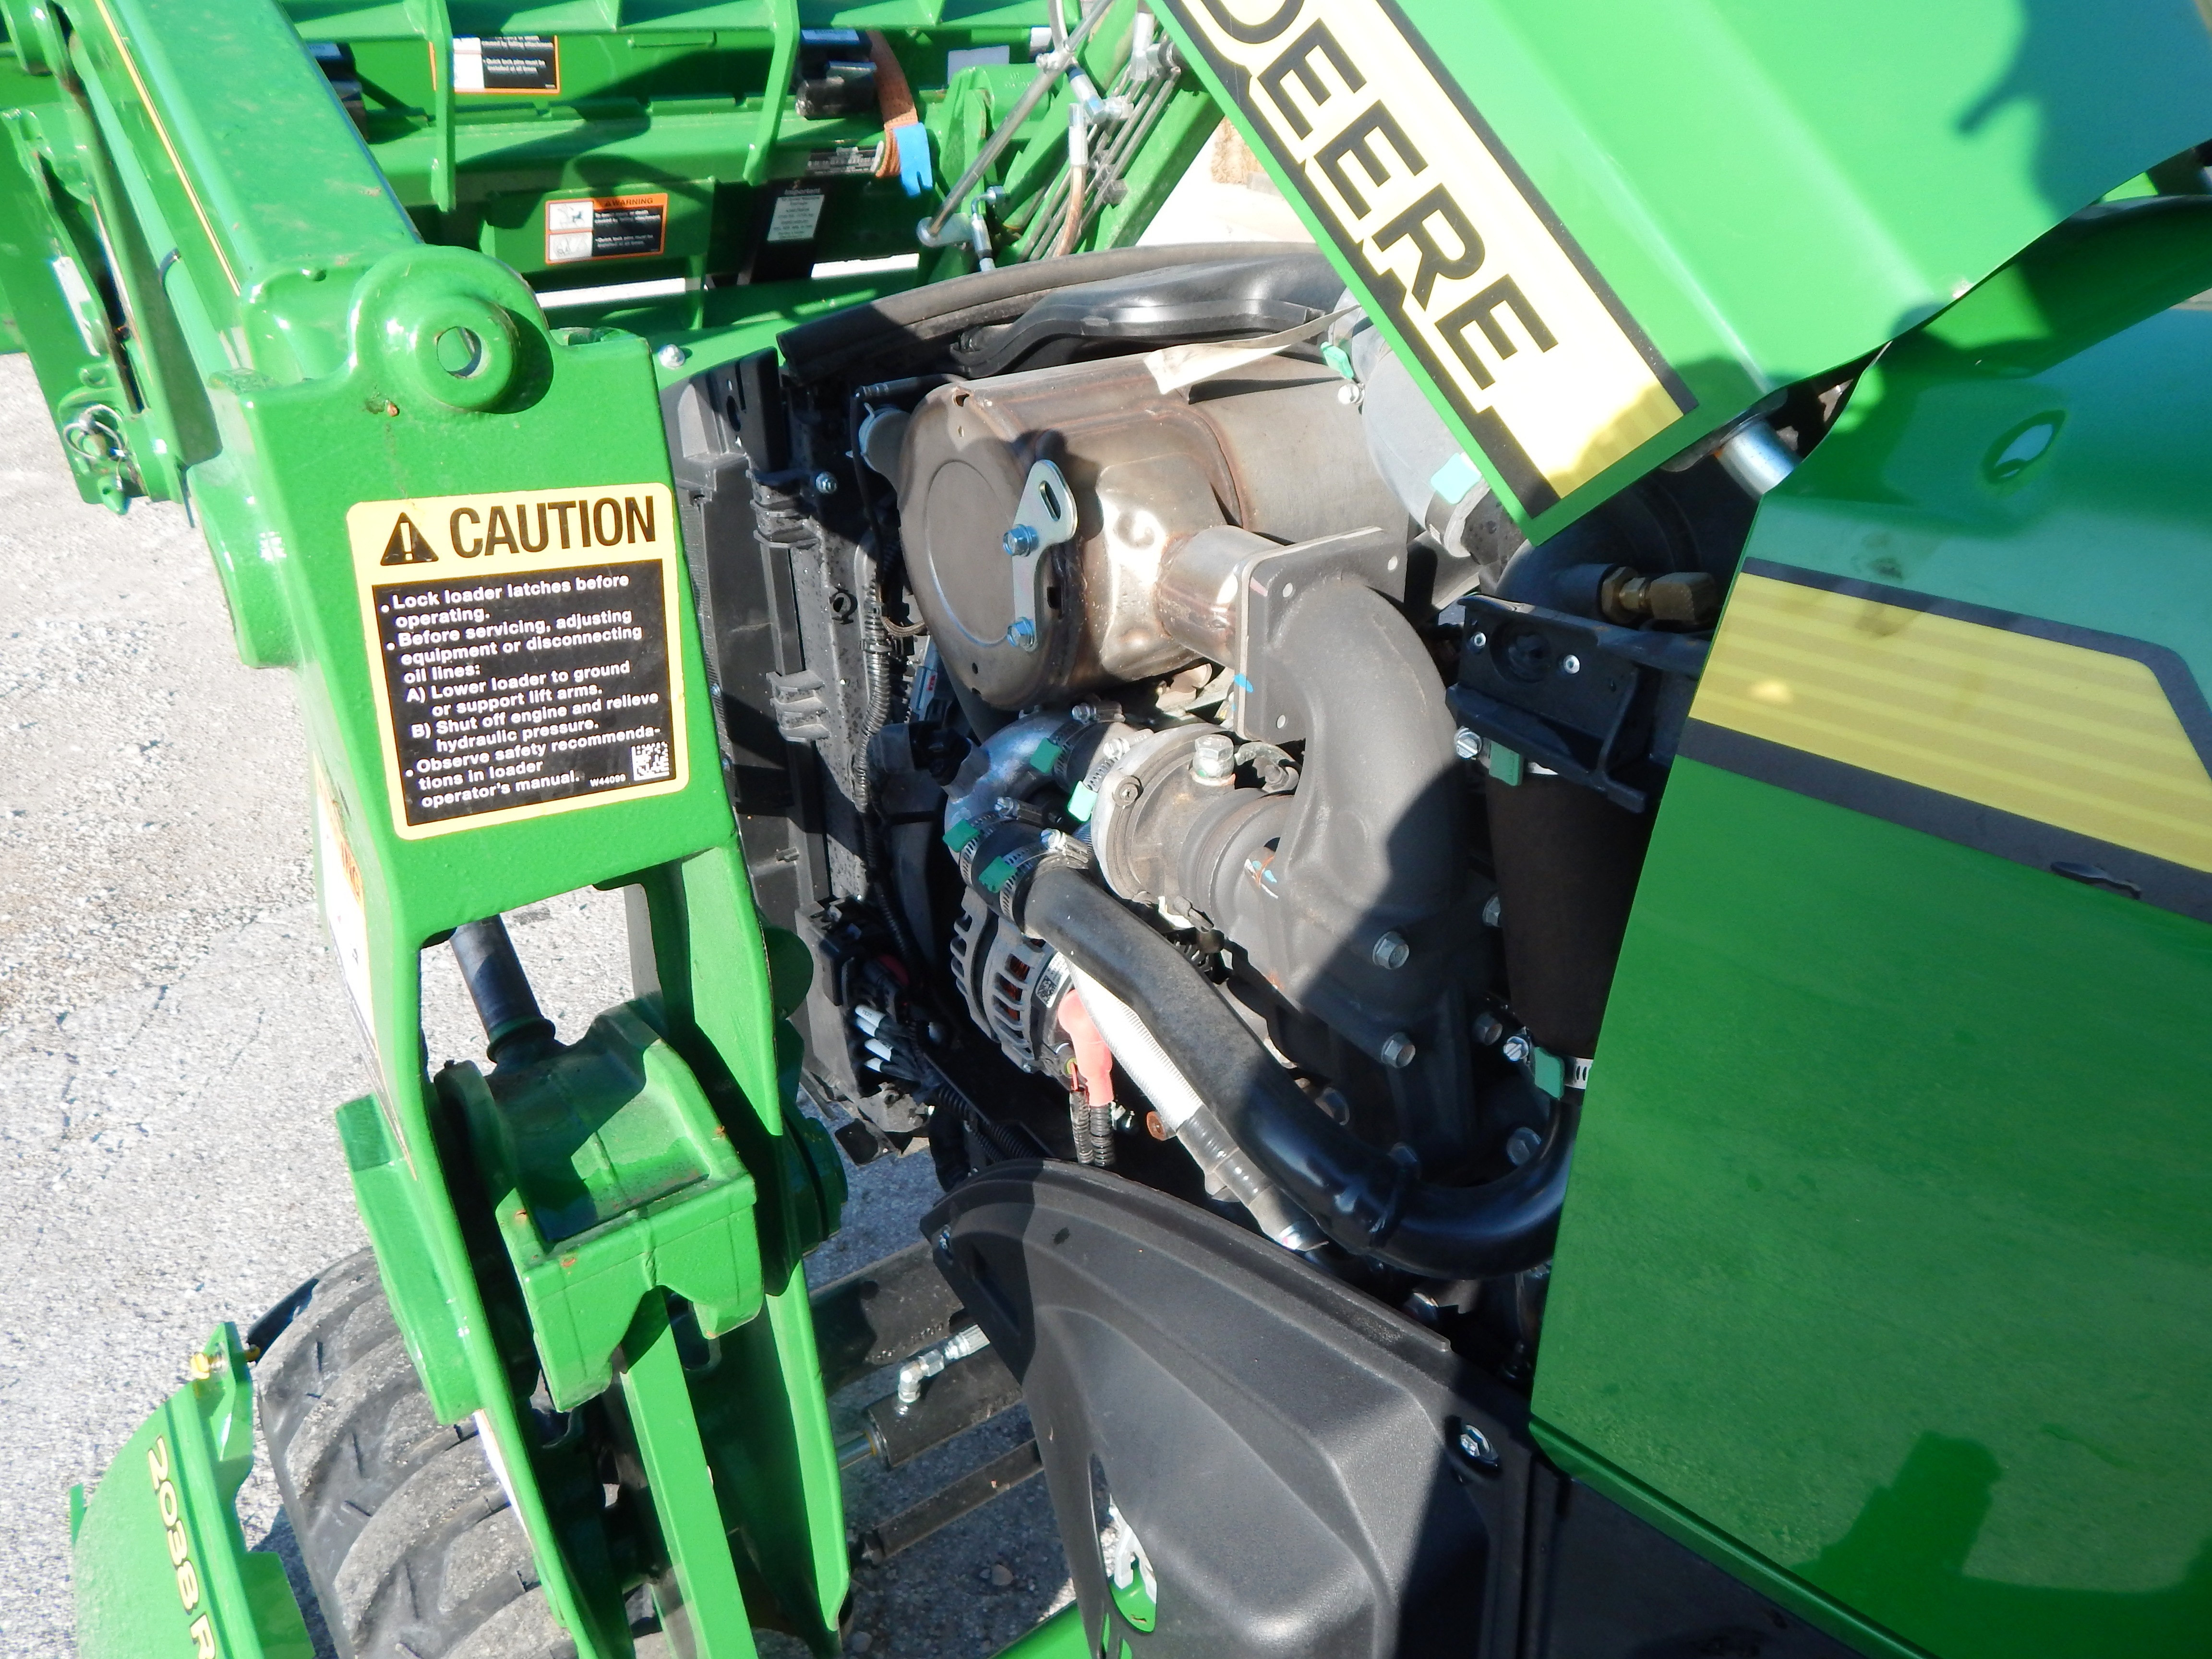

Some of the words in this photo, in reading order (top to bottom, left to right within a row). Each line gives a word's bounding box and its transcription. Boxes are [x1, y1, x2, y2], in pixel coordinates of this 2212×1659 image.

[612, 197, 653, 206] WARNING
[450, 495, 656, 559] CAUTION
[392, 591, 440, 610] Lock
[445, 586, 503, 604] loader
[507, 580, 571, 598] latches
[576, 575, 629, 591] before
[395, 607, 490, 630] operating.
[398, 629, 460, 647] Before
[465, 620, 551, 640] servicing,
[556, 610, 632, 630] adjusting
[401, 642, 498, 666] equipment
[502, 641, 521, 654] or
[526, 626, 642, 651] disconnecting
[404, 668, 427, 684] oil
[432, 663, 481, 681] lines:
[406, 686, 426, 703] A)
[431, 681, 487, 699] Lower
[491, 673, 547, 691] loader
[551, 670, 569, 684] to
[573, 660, 630, 683] ground
[411, 722, 431, 739] B)
[436, 717, 478, 735] Shut
[481, 711, 507, 728] off
[510, 706, 567, 724] engine
[572, 698, 602, 715] and
[606, 693, 659, 710] relieve
[432, 704, 452, 718] or
[456, 692, 525, 714] support
[529, 688, 553, 704] lift
[557, 685, 602, 700] arms.
[416, 753, 490, 773] Observe
[494, 743, 546, 761] safety
[551, 725, 661, 753] recommenda-
[436, 729, 518, 754] hydraulic
[521, 720, 600, 742] pressure.
[418, 774, 464, 791] tions
[468, 769, 484, 783] in
[489, 761, 543, 779] loader
[421, 782, 511, 809] operator's
[515, 769, 580, 792] manual.
[589, 774, 626, 787] W44099
